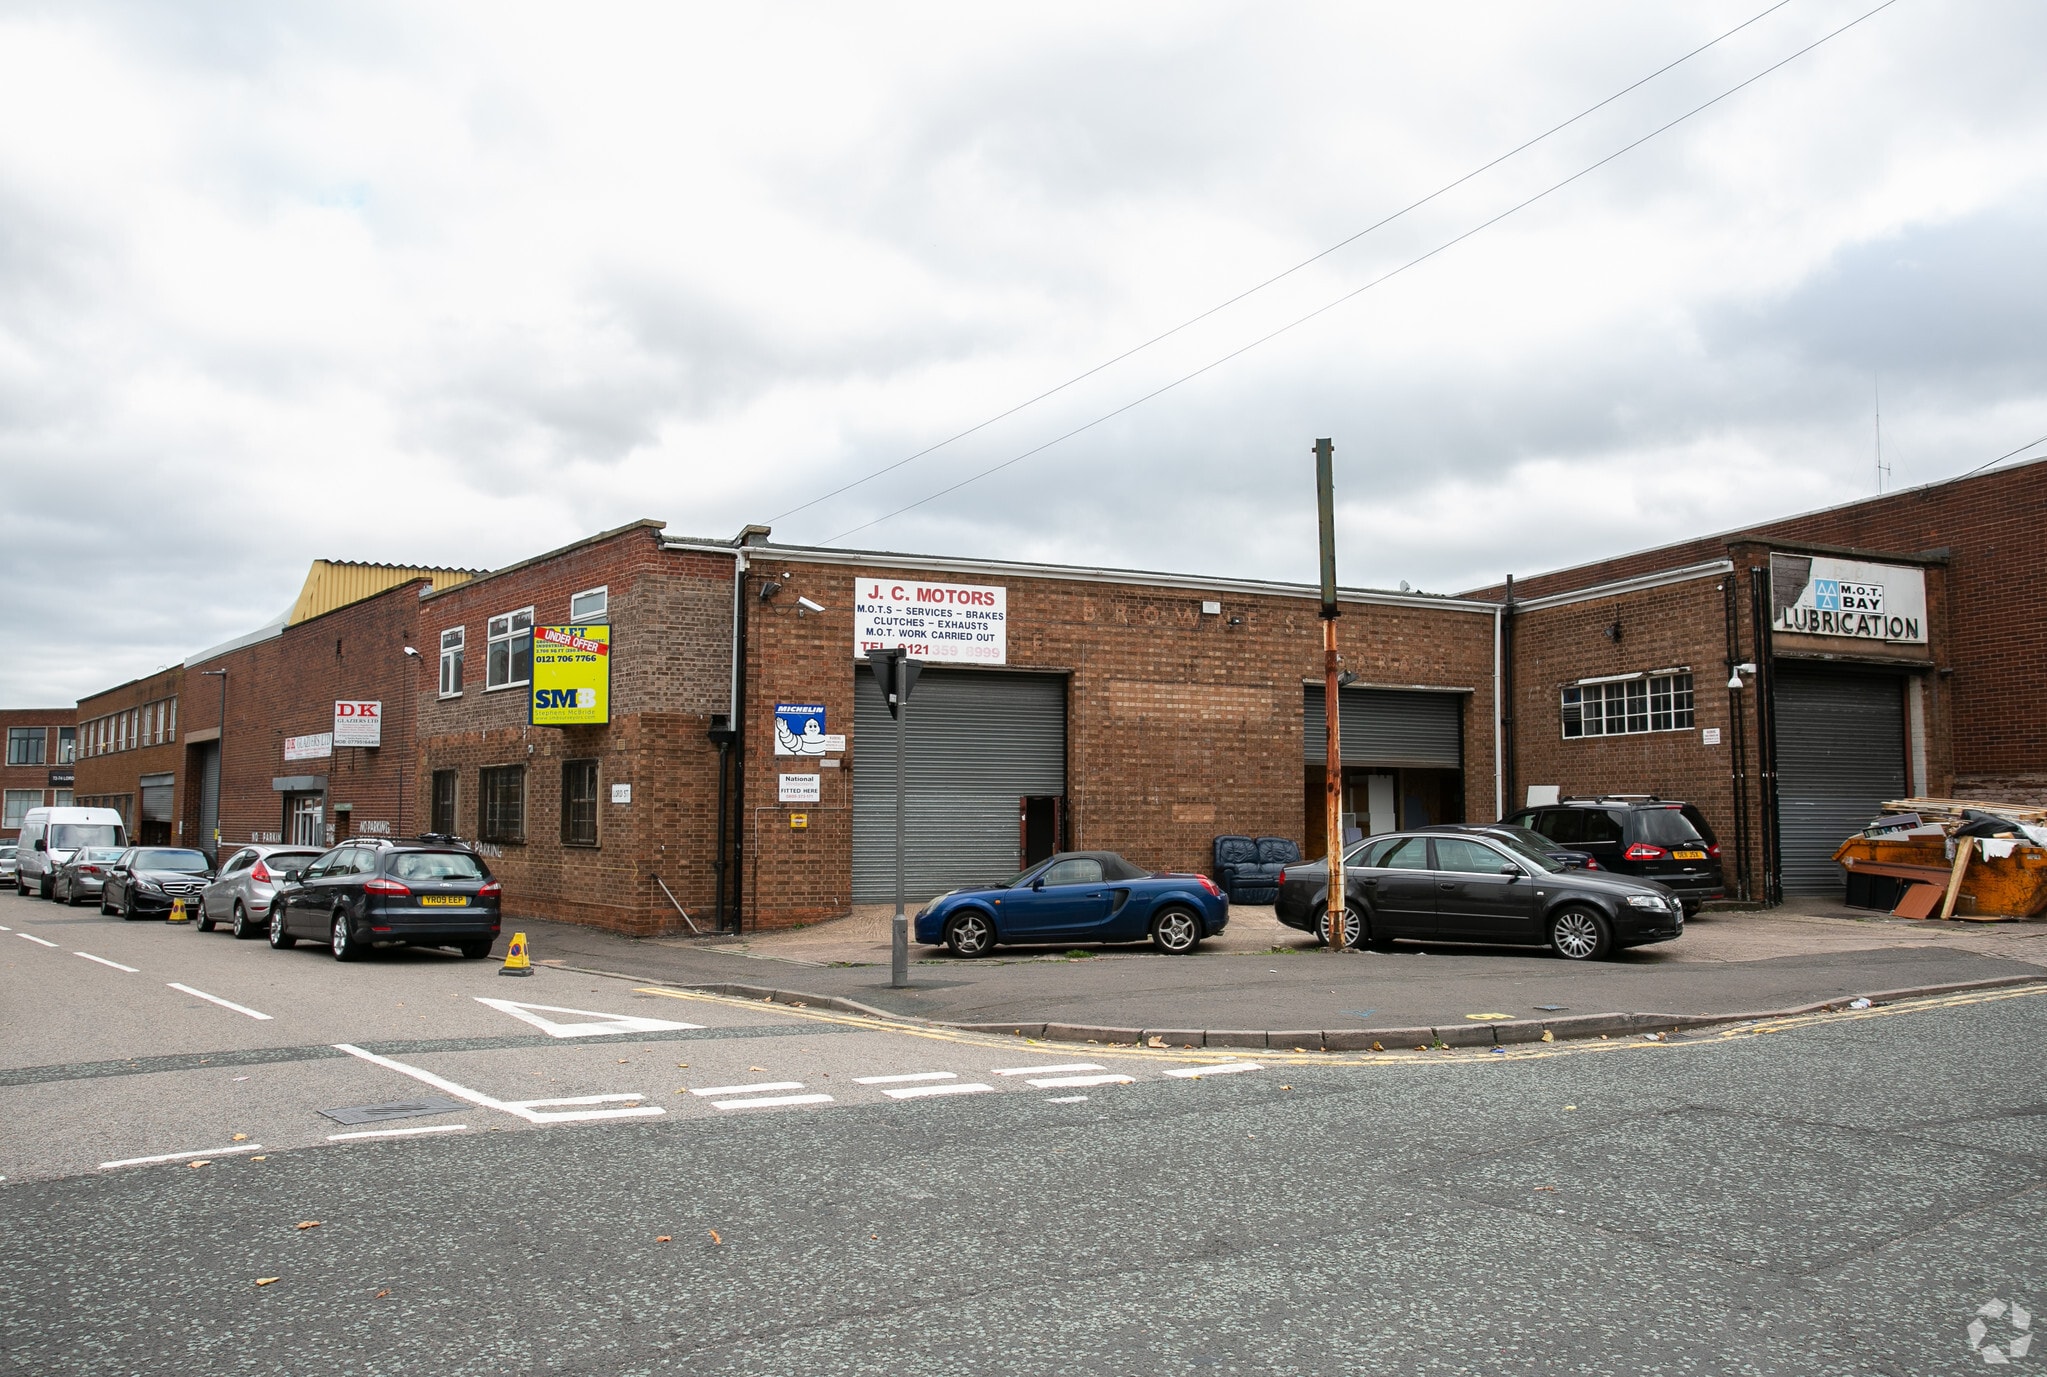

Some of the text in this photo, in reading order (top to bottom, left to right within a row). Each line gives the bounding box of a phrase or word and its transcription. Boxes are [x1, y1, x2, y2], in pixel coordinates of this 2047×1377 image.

[867, 584, 995, 606] J. C. MOTORS
[1840, 585, 1883, 611] M.O.T. BAY
[856, 604, 893, 614] M.O.T.S
[905, 607, 953, 618] SERVICES
[965, 610, 1004, 621] BRAKES
[873, 616, 925, 627] CLUTCHES
[937, 619, 989, 631] EXHAUSTS
[1781, 606, 1919, 639] LUBRICATION
[544, 629, 599, 653] UNDER OFFER
[865, 627, 995, 642] M.O.T. WORK CARRIED OUT
[932, 644, 958, 657] 359
[535, 655, 555, 663] 0121
[557, 655, 574, 663] 706
[535, 688, 596, 709] SMB
[777, 705, 824, 713] MICHELIN
[286, 738, 296, 750] DK
[359, 820, 391, 834] NO PARKING
[426, 896, 446, 904] YR09
